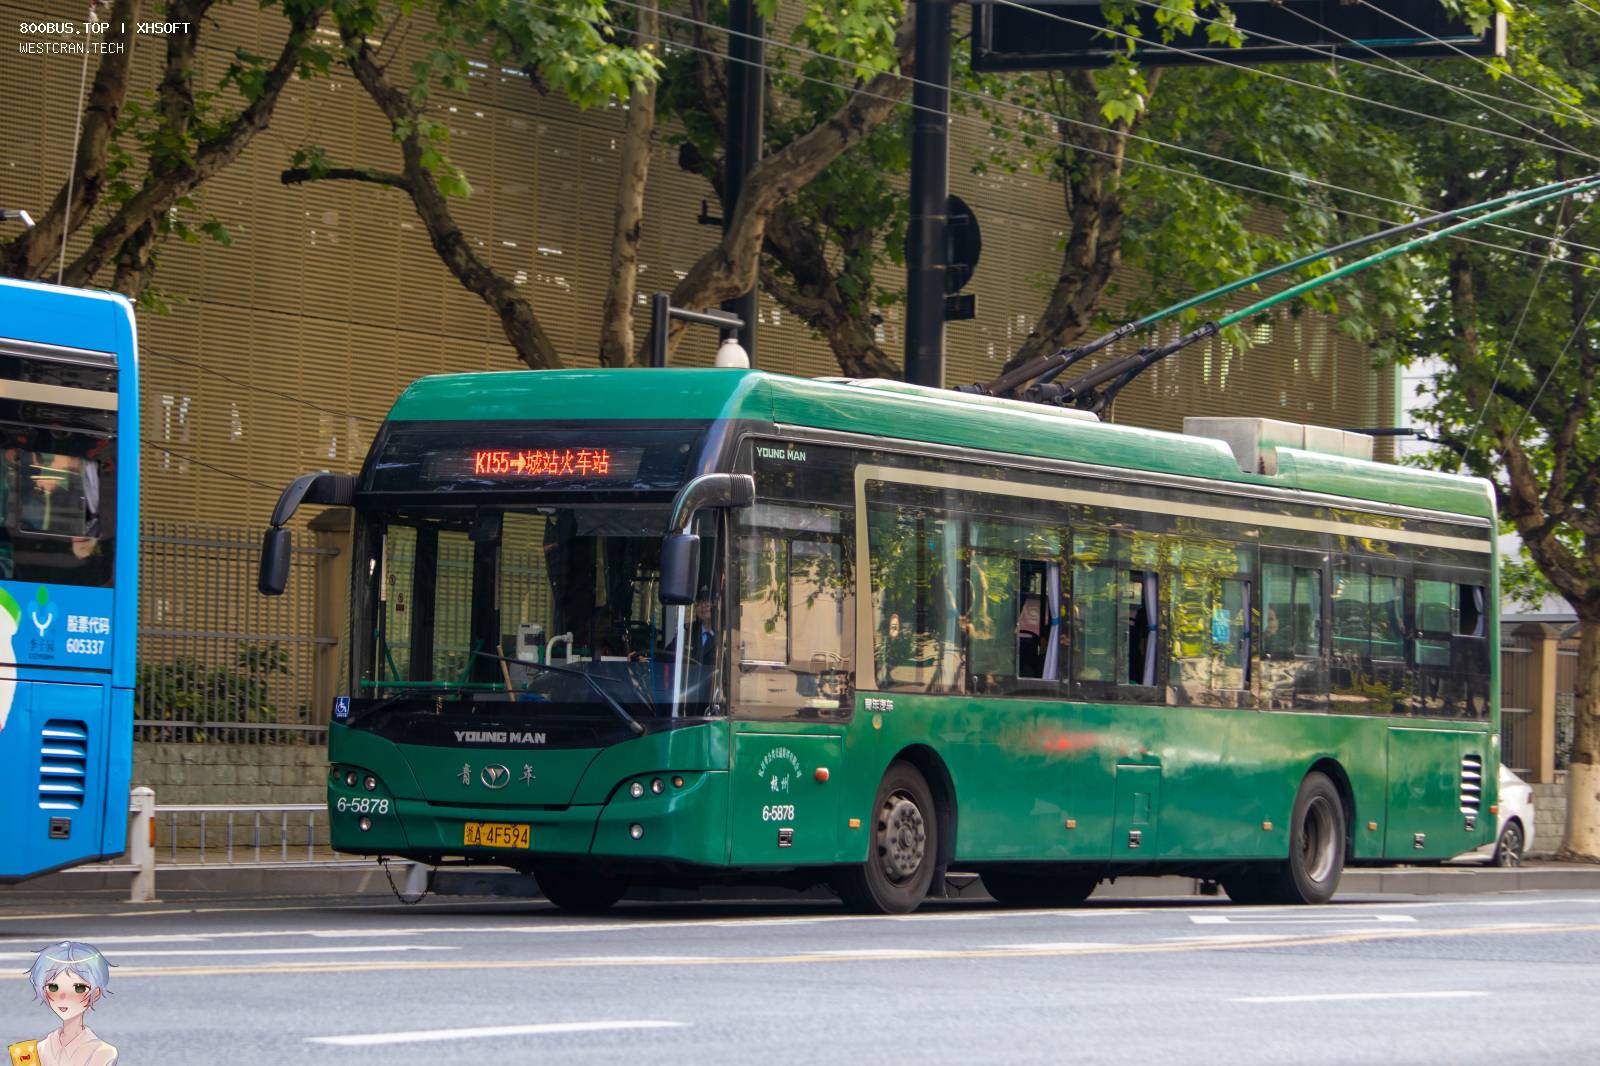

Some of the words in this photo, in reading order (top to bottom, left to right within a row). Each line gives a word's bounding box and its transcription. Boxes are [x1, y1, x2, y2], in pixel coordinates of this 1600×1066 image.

[756, 446, 785, 459] YOUNG
[787, 449, 806, 461] MAN
[475, 451, 510, 474] K155
[525, 449, 610, 475] 城站火车站
[66, 638, 104, 655] 605337
[454, 731, 507, 743] YOUNG
[509, 732, 546, 744] MAN
[337, 797, 389, 814] 6-5878
[762, 805, 795, 821] 6-5878
